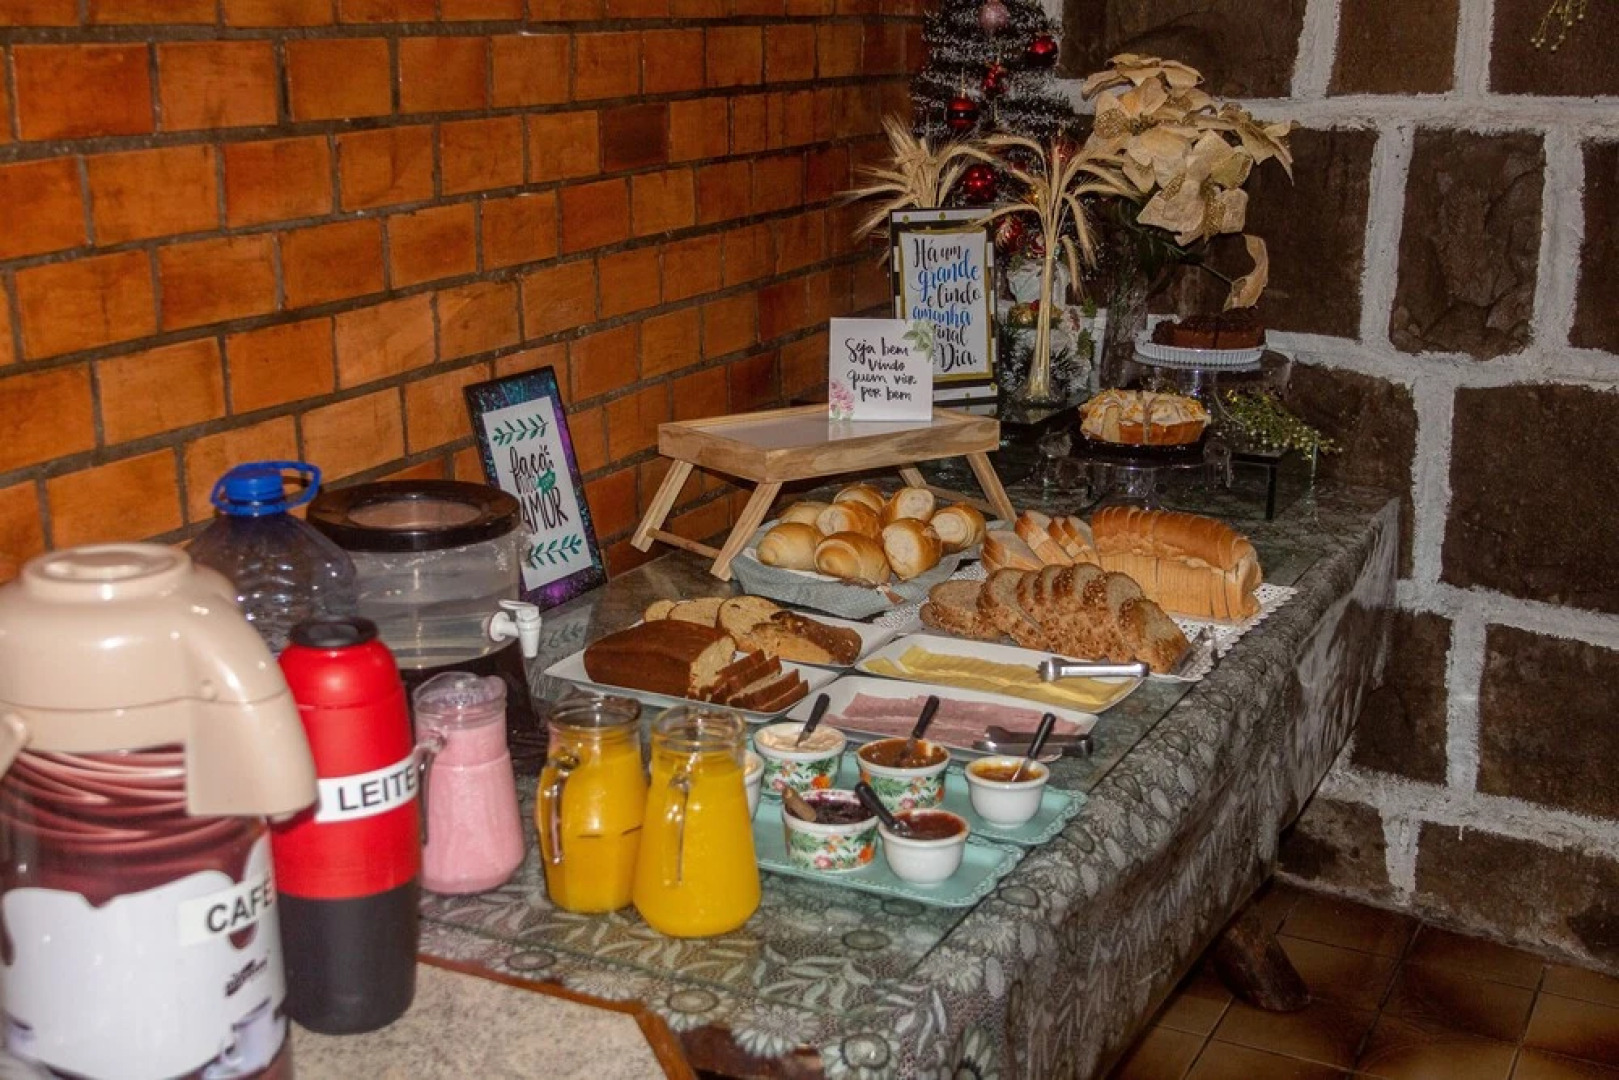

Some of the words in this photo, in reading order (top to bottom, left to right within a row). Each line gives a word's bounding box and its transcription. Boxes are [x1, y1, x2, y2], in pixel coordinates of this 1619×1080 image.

[910, 249, 979, 302] grande
[937, 281, 981, 308] lindo
[845, 337, 876, 364] Seja
[881, 336, 909, 356] bem
[886, 386, 912, 401] bem
[338, 764, 416, 812] LEITE
